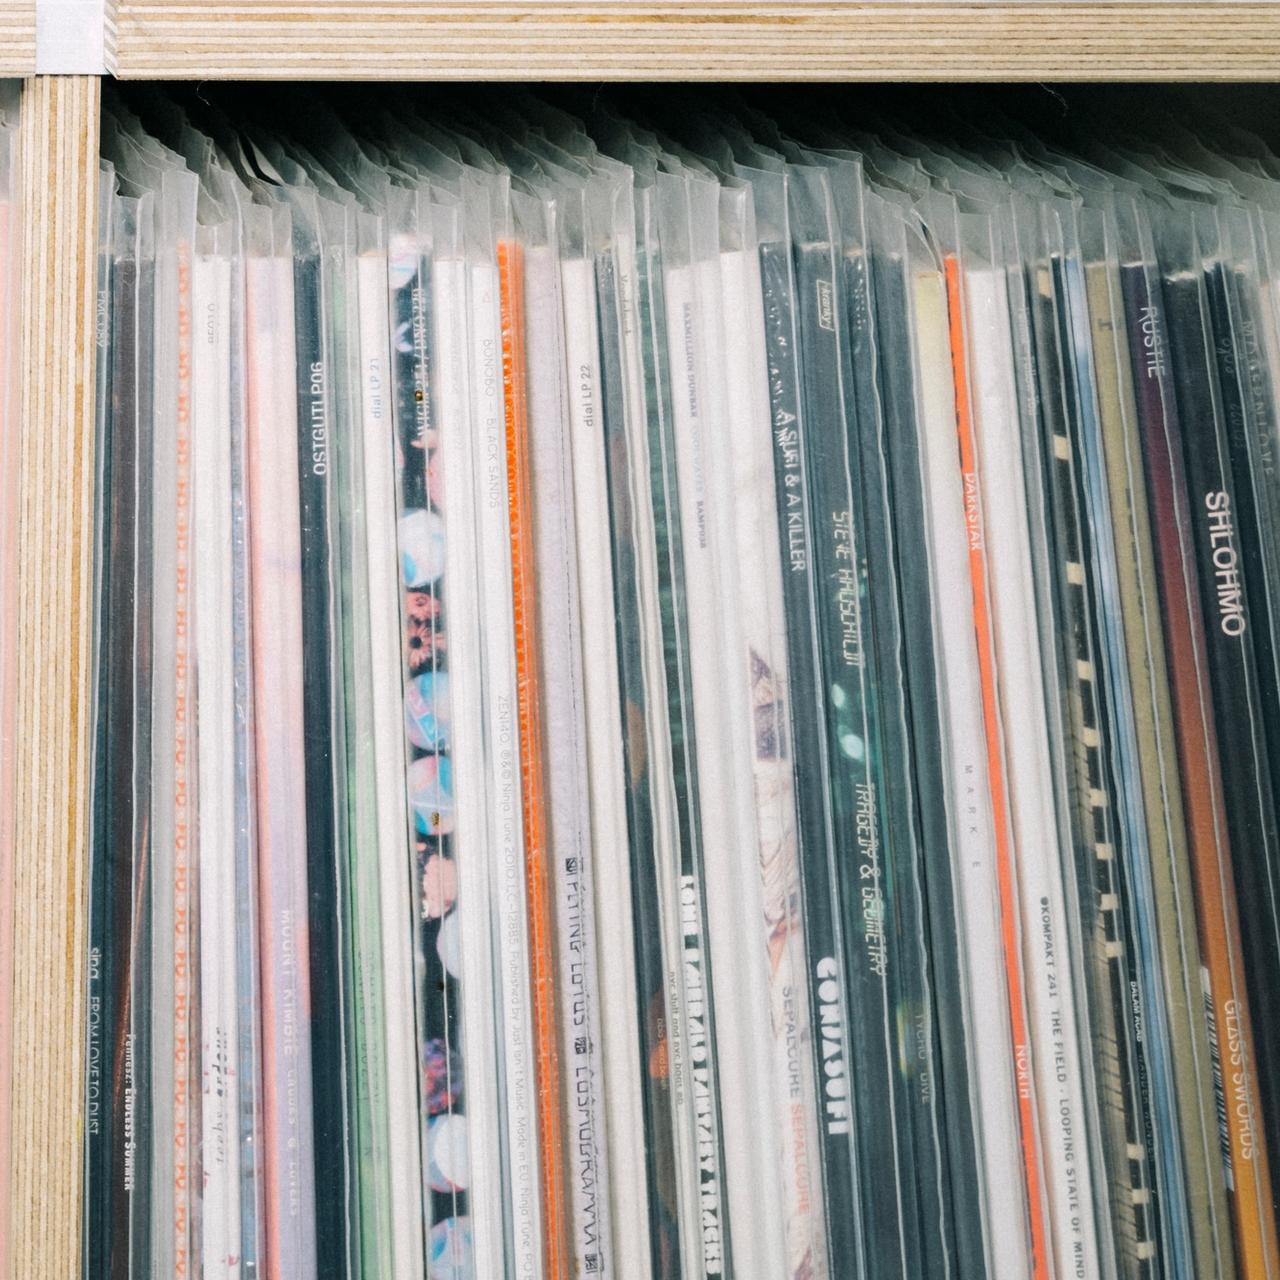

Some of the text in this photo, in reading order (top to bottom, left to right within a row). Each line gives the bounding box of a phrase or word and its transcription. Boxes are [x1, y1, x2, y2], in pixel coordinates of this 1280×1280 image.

[368, 376, 381, 392] LP
[578, 365, 593, 428] dial LP 22
[369, 395, 382, 421] dial
[486, 463, 501, 509] SANDS
[1203, 489, 1247, 638] SHLOHMO
[1136, 305, 1257, 1162] RUSTIE GLASS SWORDS
[87, 1040, 100, 1079] LOVE
[87, 1080, 100, 1099] TO
[1038, 904, 1087, 1279] KOMPAKT 241 THE FIELD LOOPING STATE OF MIND
[87, 1101, 100, 1136] DUST
